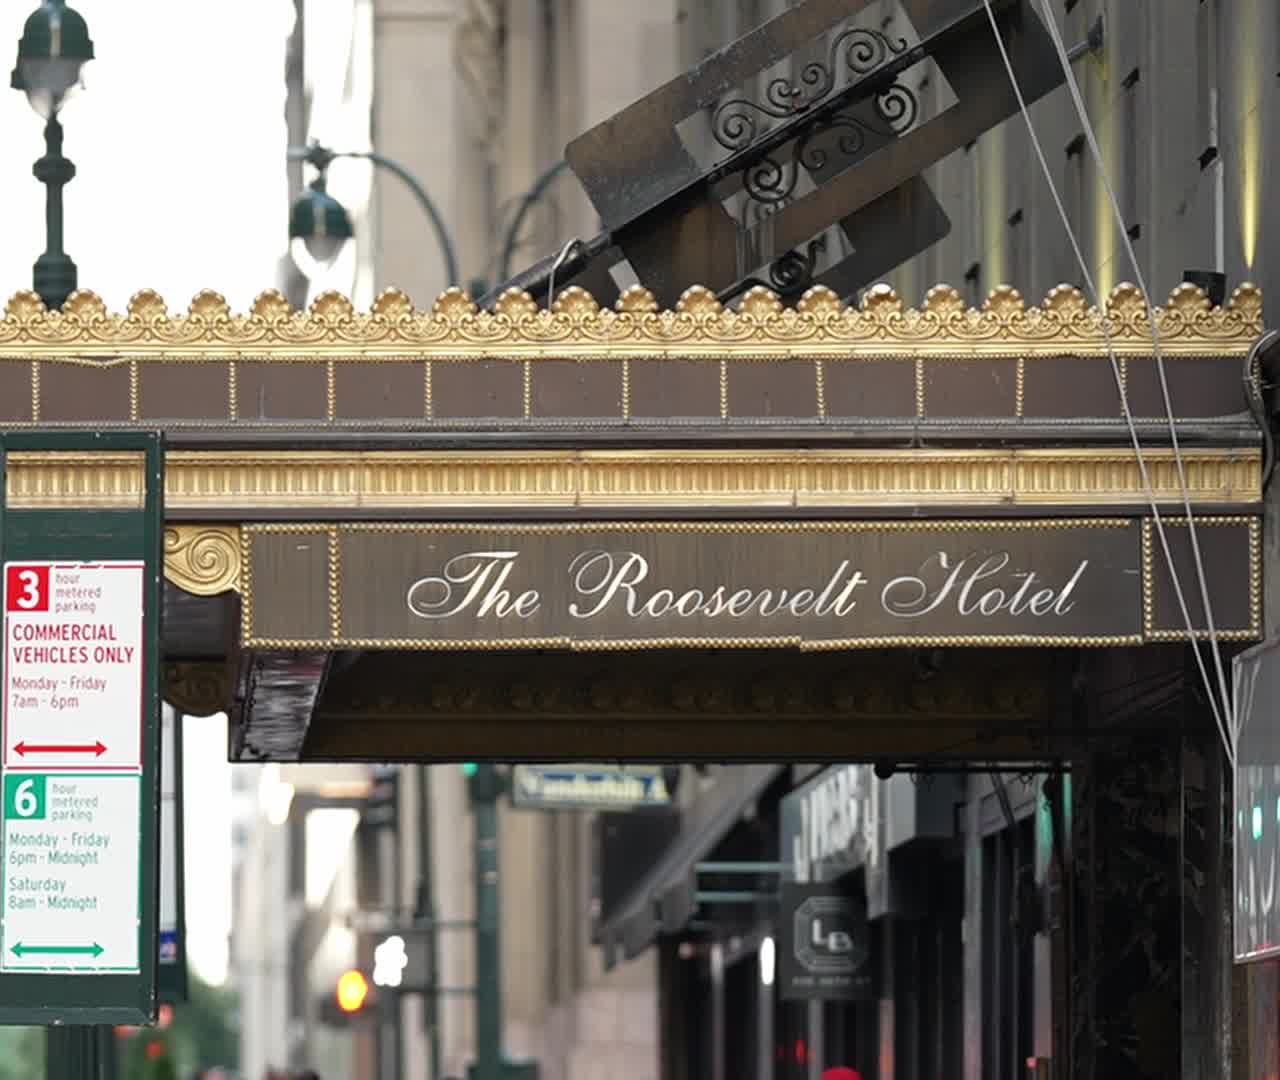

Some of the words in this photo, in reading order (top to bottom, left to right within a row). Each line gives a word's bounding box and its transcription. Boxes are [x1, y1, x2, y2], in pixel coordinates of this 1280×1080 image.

[55, 573, 80, 585] hour
[407, 551, 542, 618] The
[568, 549, 868, 618] Roosevelt
[881, 551, 1089, 617] Hotel
[17, 570, 40, 609] 3
[55, 586, 102, 599] metered
[55, 602, 97, 615] parking
[12, 624, 118, 641] COMMERCIAL
[13, 646, 89, 663] VEHICLES
[93, 646, 135, 663] ONLY
[11, 676, 59, 692] Monday
[70, 675, 108, 692] Friday
[13, 694, 39, 708] 7am
[50, 694, 80, 711] 6pm
[51, 783, 77, 794] hour
[14, 778, 38, 817] 6
[51, 796, 99, 809] metered
[51, 810, 94, 823] parking
[9, 832, 59, 848] Monday
[71, 832, 110, 848] Friday
[9, 850, 38, 867] 6pm
[47, 851, 99, 867] Midnight
[9, 877, 67, 893] Saturday
[8, 895, 37, 910] 8am
[47, 895, 98, 912] Midnight
